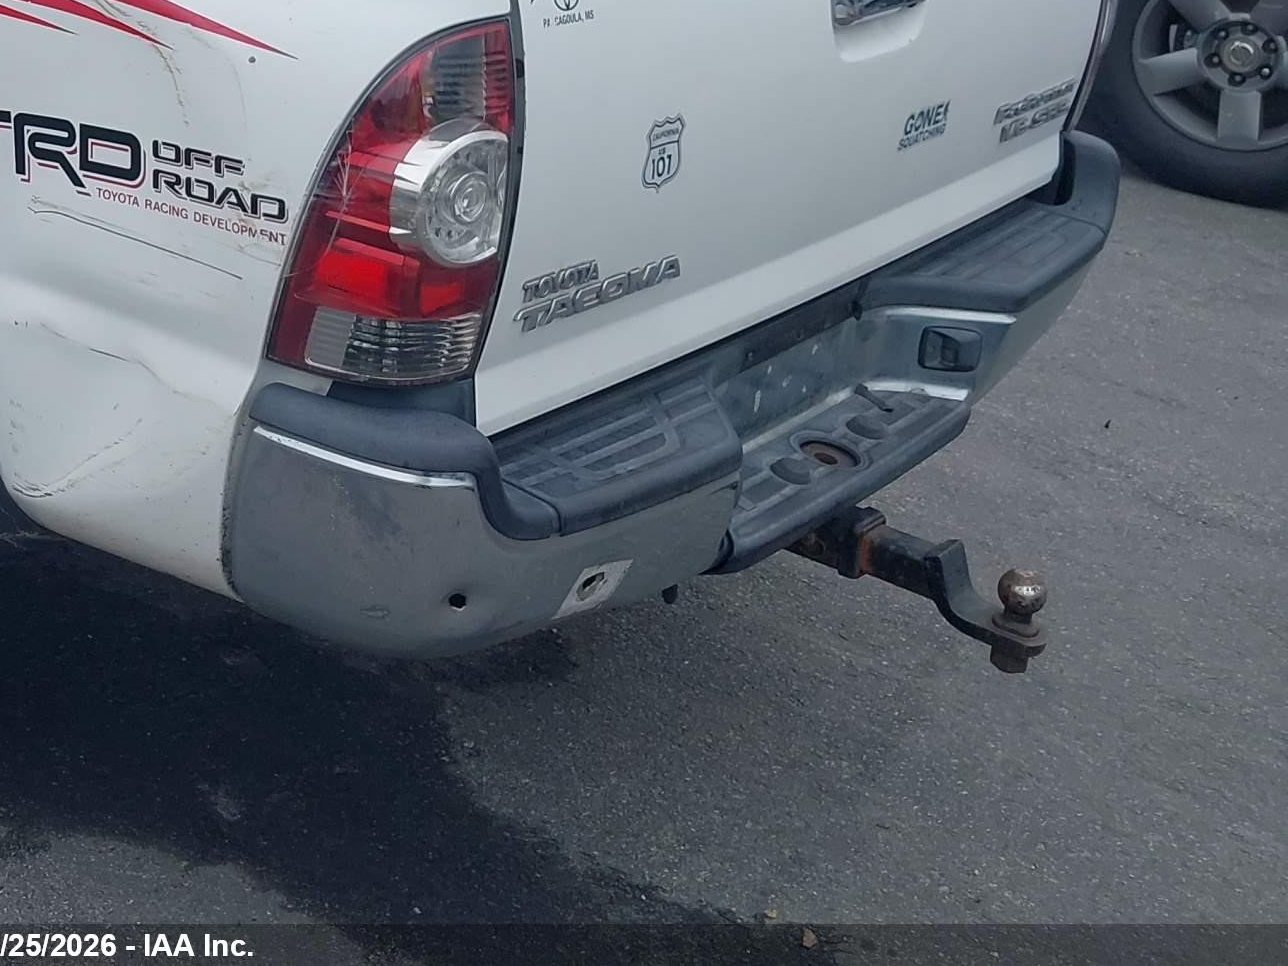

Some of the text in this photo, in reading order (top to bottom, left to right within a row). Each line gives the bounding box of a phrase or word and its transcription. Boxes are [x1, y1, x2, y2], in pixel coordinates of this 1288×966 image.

[903, 99, 947, 136] GONE
[151, 139, 245, 177] OFF
[652, 153, 672, 179] 101
[96, 187, 287, 246] TOYOTA RACING DEVELOPMENT
[152, 168, 289, 224] ROAD
[513, 254, 680, 332] TACOMA
[522, 259, 599, 303] TOYOTA
